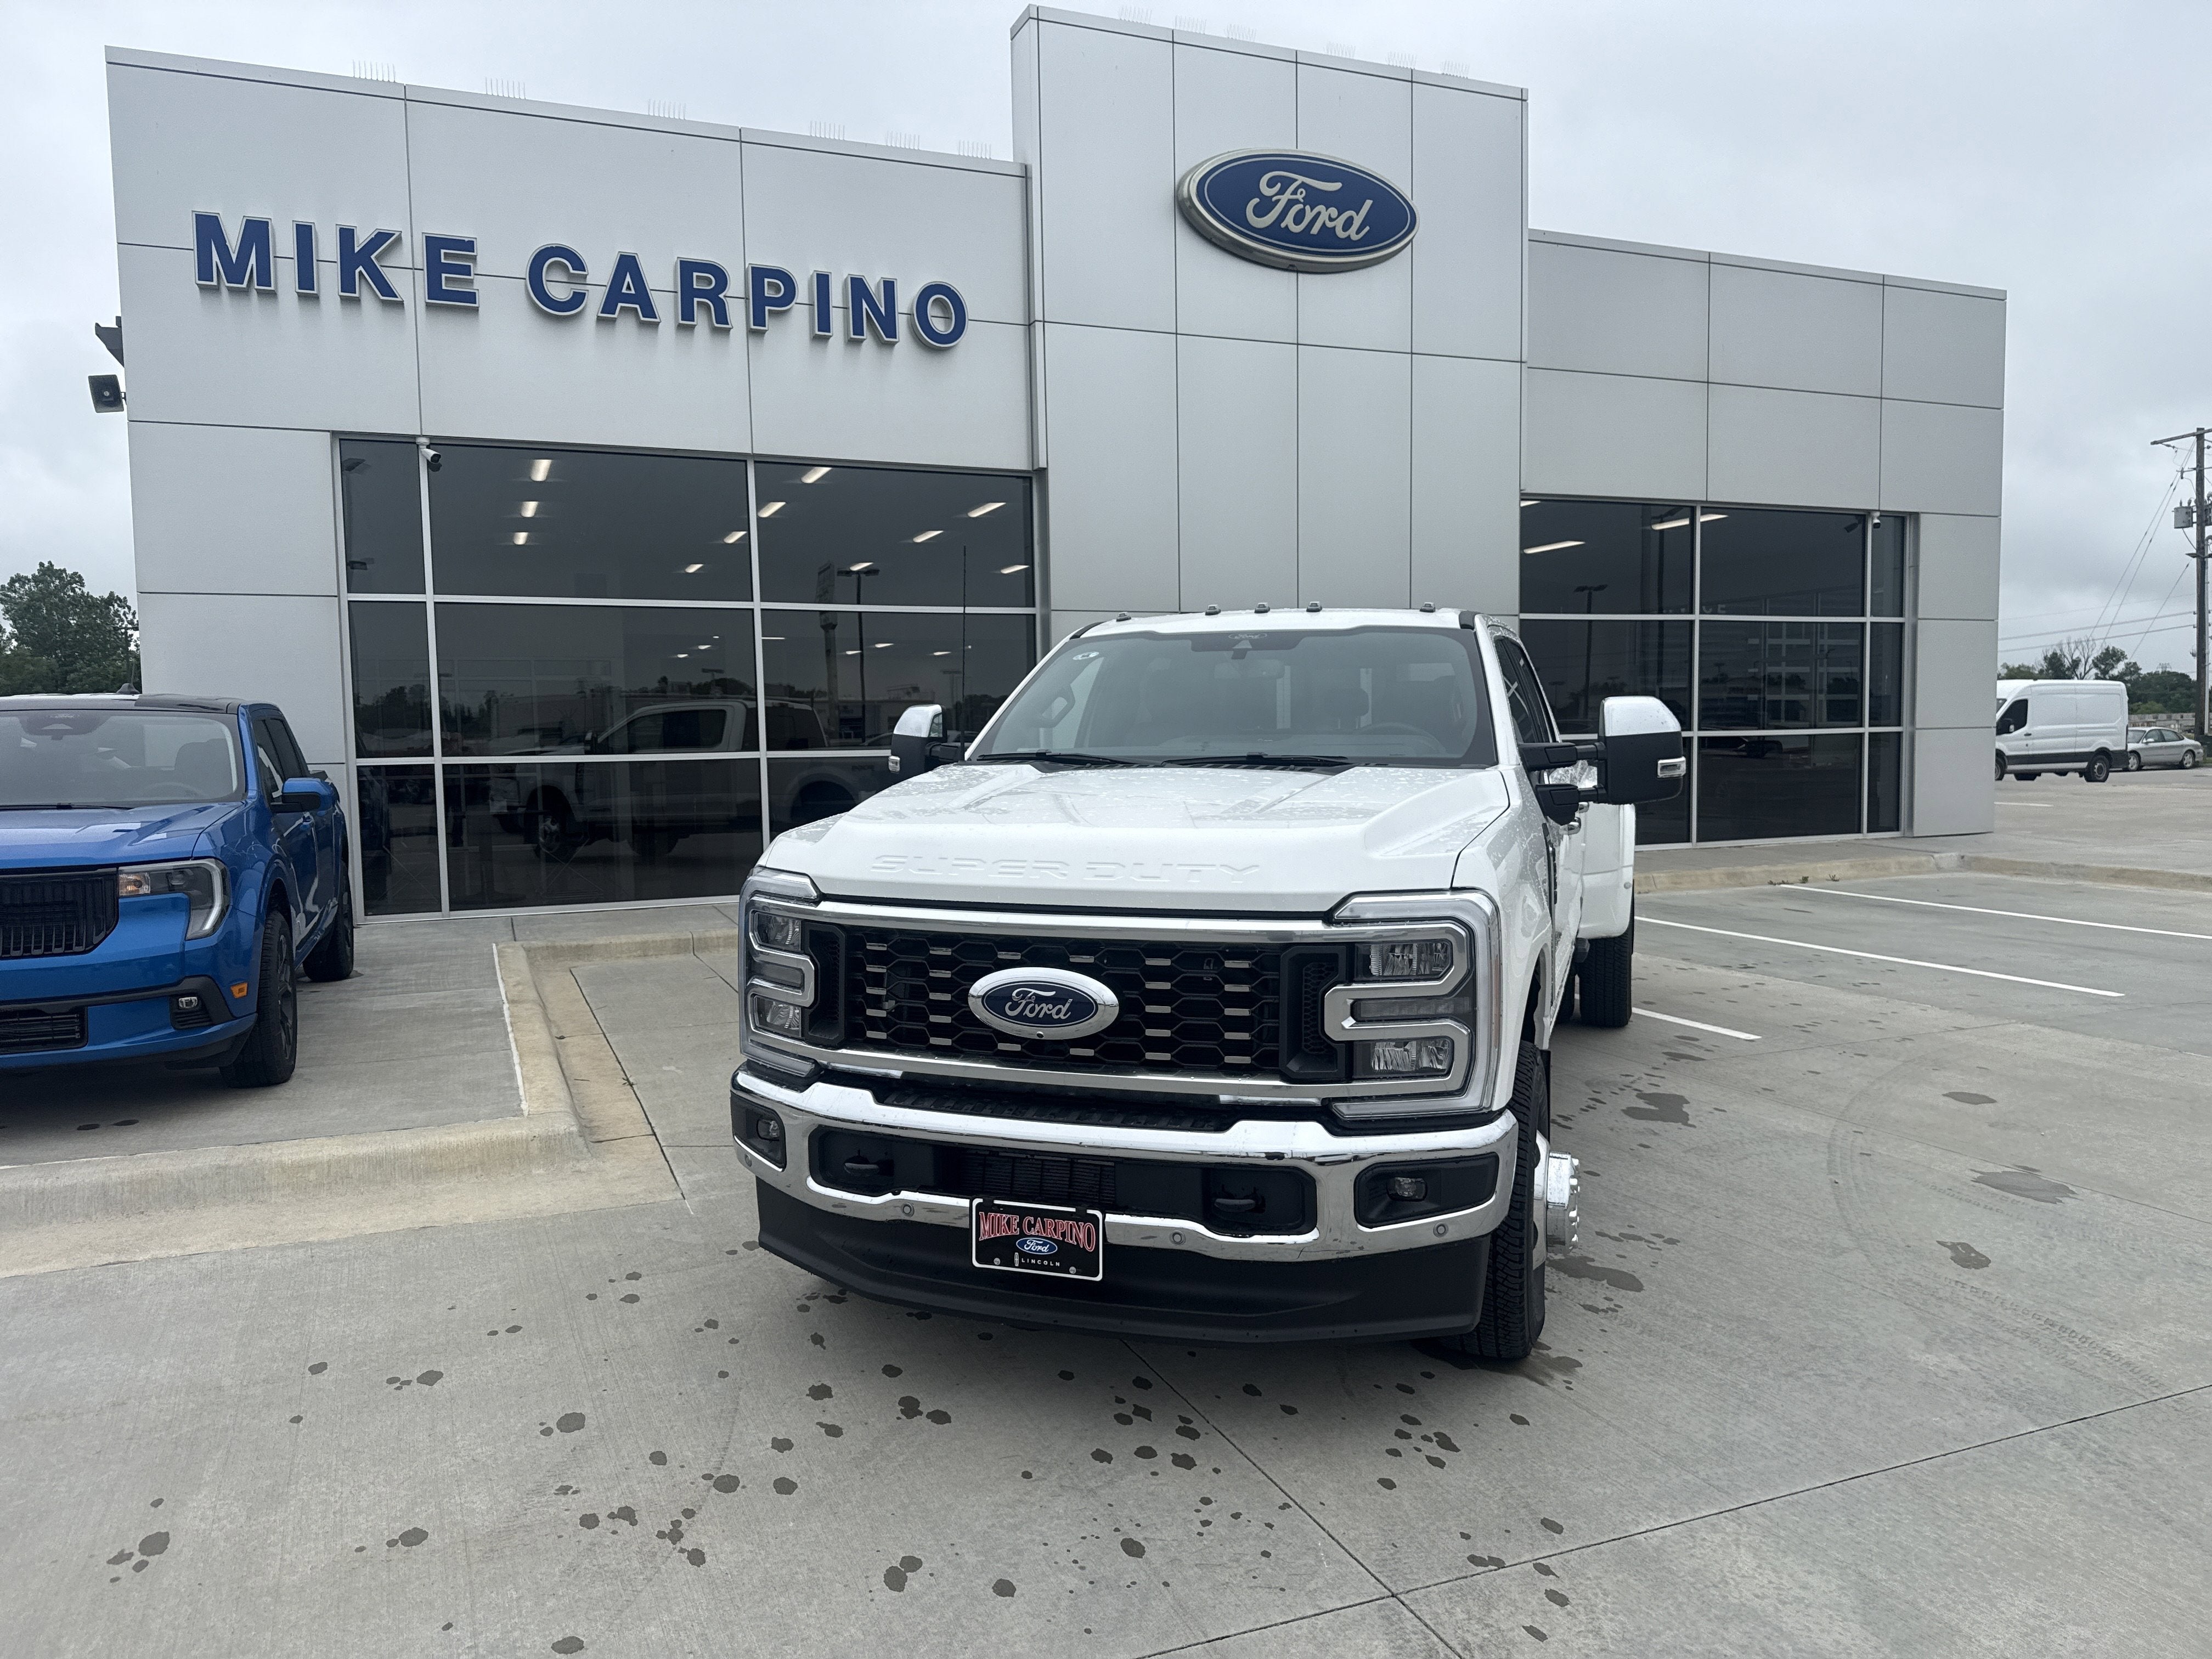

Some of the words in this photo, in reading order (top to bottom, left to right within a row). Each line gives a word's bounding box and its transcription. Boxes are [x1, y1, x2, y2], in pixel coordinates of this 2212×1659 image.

[1246, 171, 1373, 241] Ford
[192, 211, 480, 307] MIKE
[525, 244, 968, 349] CARPINO
[870, 855, 1069, 879] SUPER
[1083, 861, 1260, 883] DUTY
[1005, 988, 1073, 1019] Ford
[979, 1212, 1019, 1241] MIKE
[1022, 1216, 1096, 1252] CARPINO
[1024, 1239, 1049, 1252] Ford
[1021, 1257, 1060, 1267] LINCOLN
